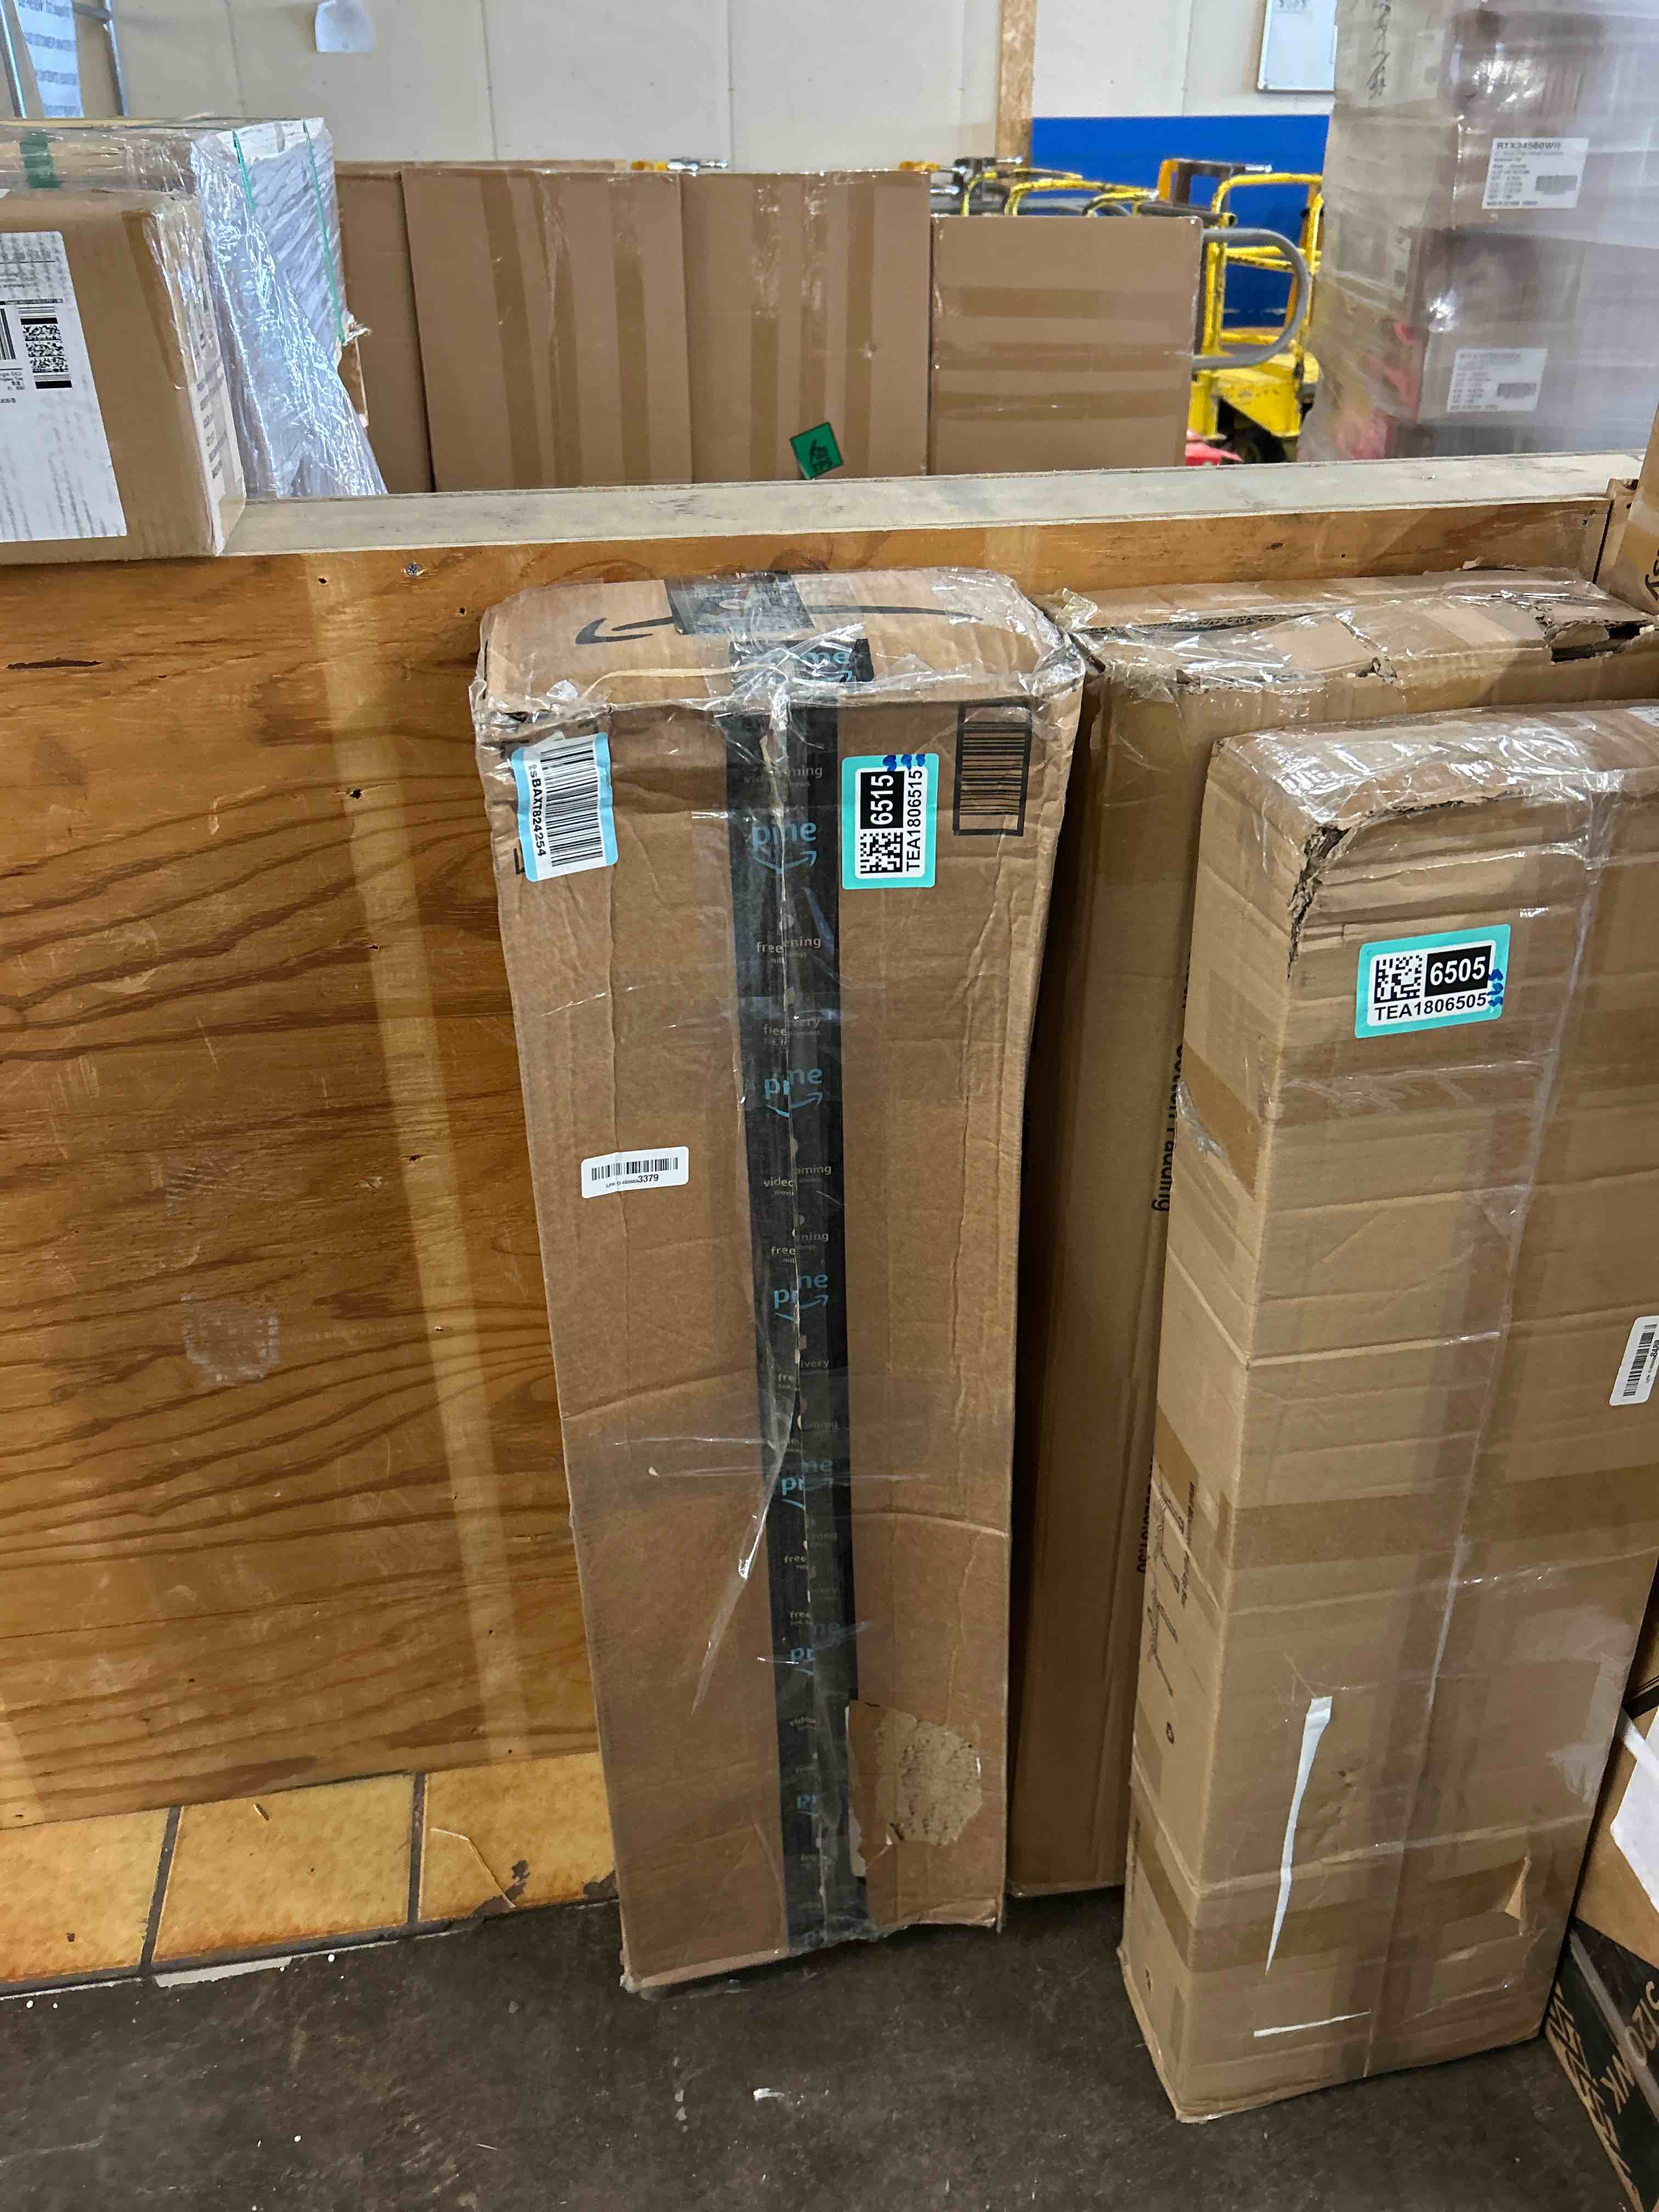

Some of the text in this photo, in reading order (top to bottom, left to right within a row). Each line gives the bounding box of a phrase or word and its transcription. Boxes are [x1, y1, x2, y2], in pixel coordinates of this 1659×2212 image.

[870, 774, 894, 826] 6515
[906, 770, 923, 872] TEA1806515
[1430, 956, 1486, 985] 6505
[1374, 994, 1487, 1021] TEA1806505
